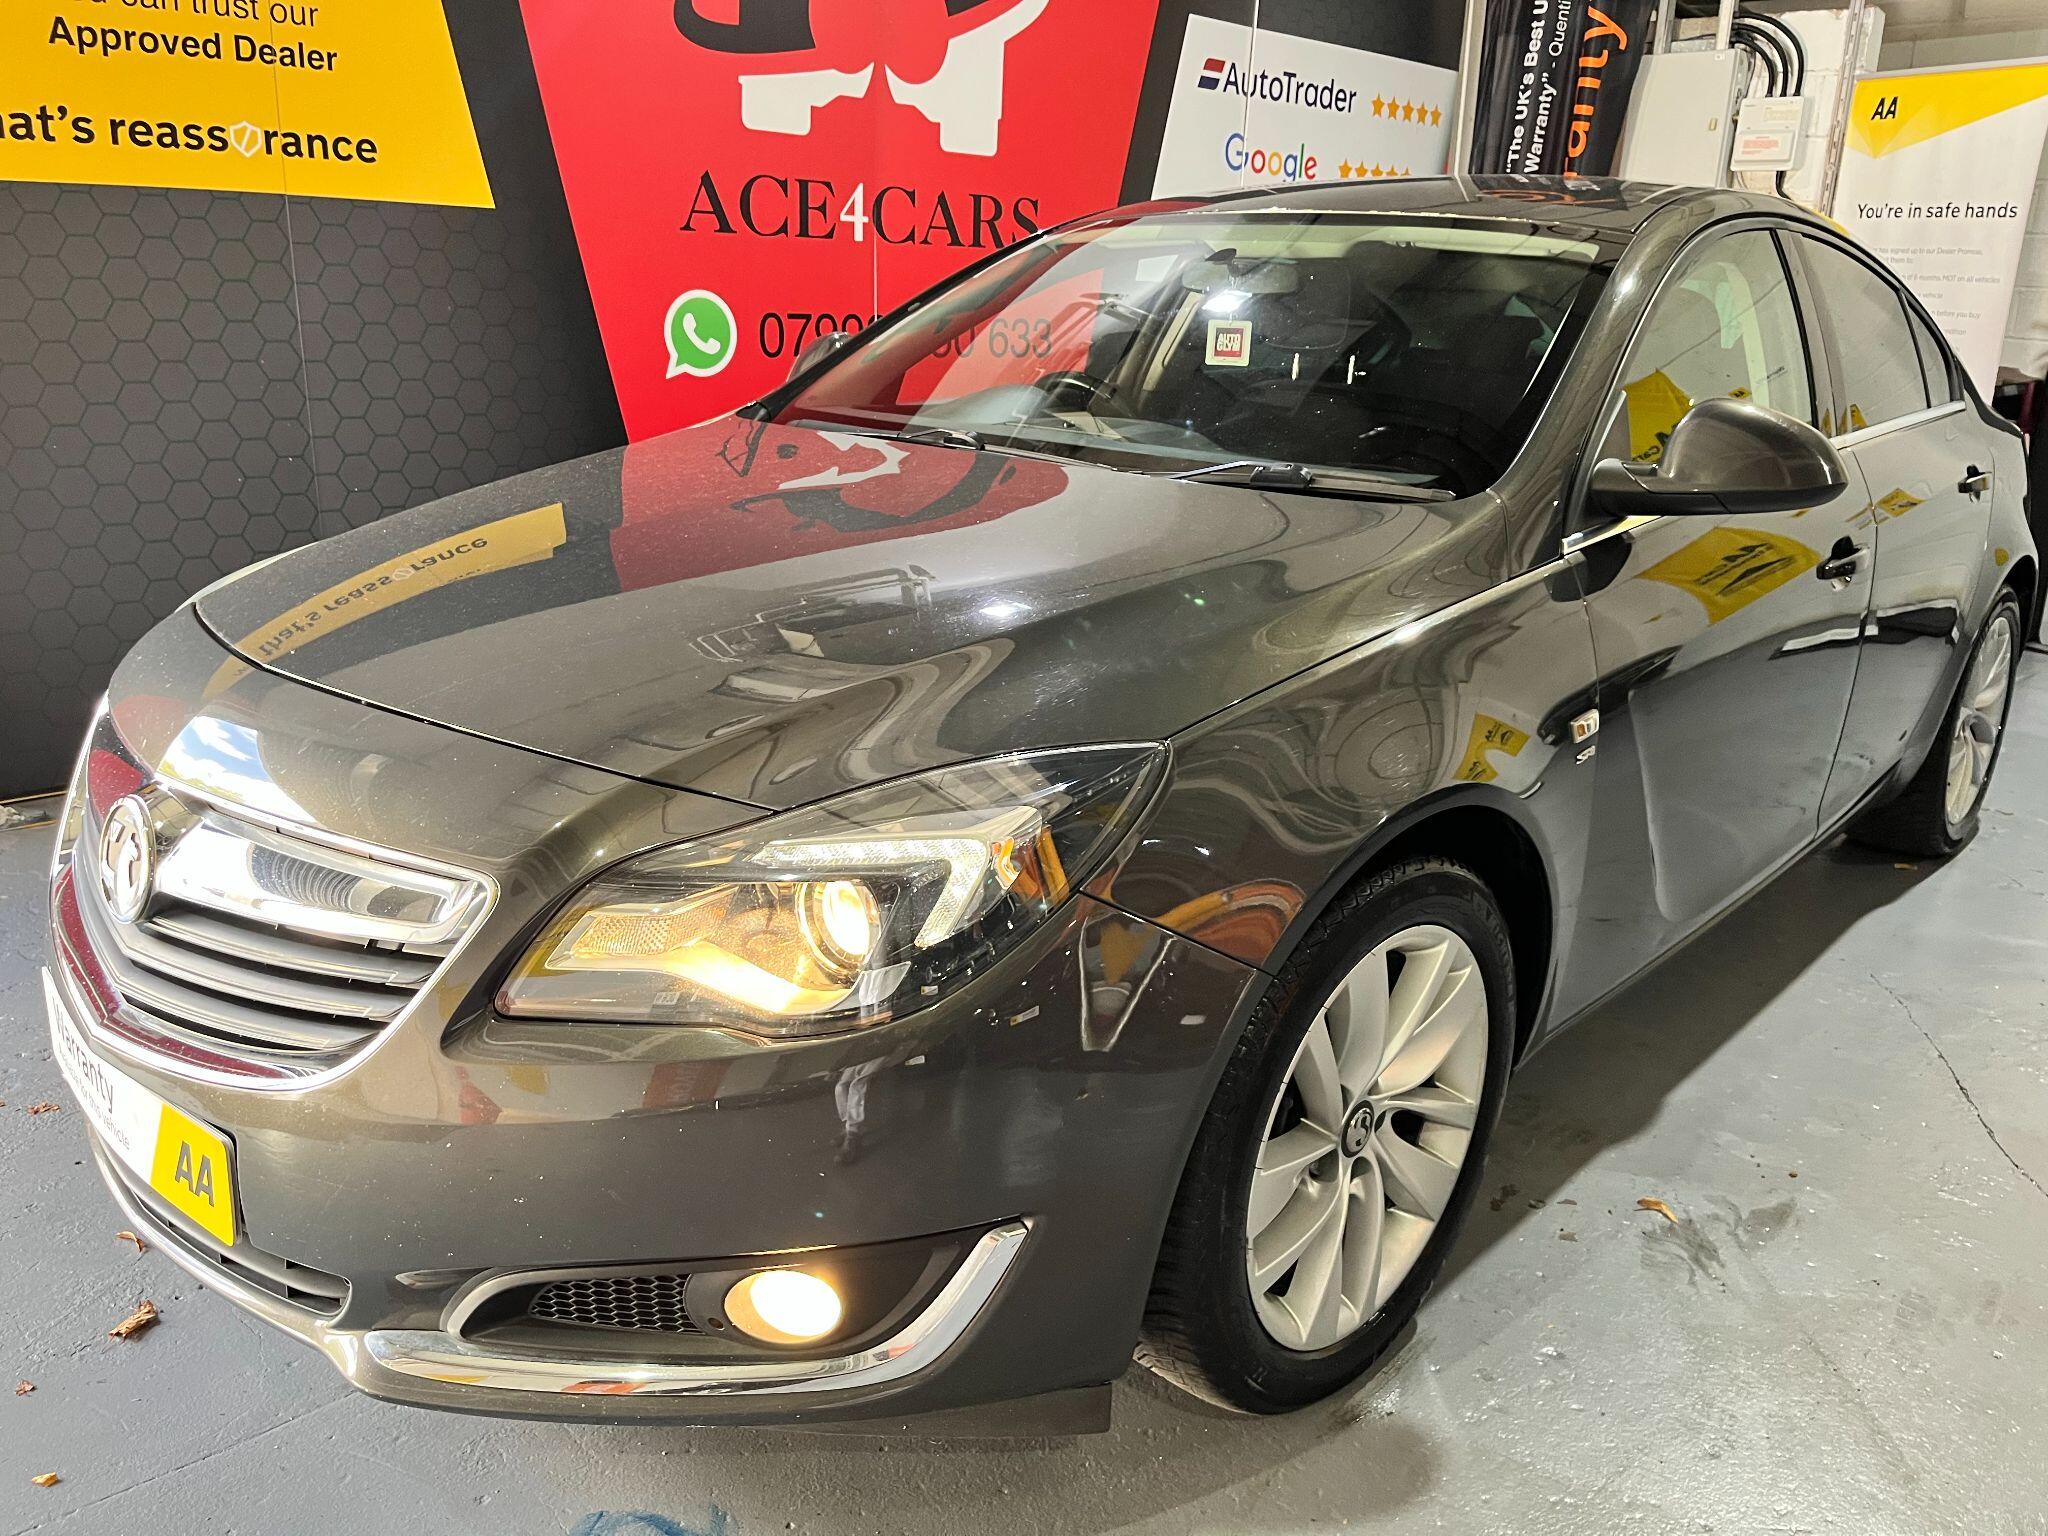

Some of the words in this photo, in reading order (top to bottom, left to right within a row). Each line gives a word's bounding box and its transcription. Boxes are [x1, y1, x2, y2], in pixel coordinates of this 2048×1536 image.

[270, 2, 319, 27] our
[48, 15, 223, 59] Approved
[233, 34, 338, 72] Dealer
[1523, 19, 1546, 67] Best
[1222, 62, 1358, 114] AutoTrader
[1870, 96, 1899, 121] AA
[0, 104, 96, 145] at's
[1224, 132, 1318, 181] Google
[679, 169, 1040, 248] ACE4CARS
[1857, 203, 1903, 219] You're
[1908, 202, 1922, 218] in
[1926, 202, 1960, 219] safe
[1965, 202, 2019, 219] hands
[759, 312, 883, 358] 079
[988, 318, 1052, 359] 633
[174, 1139, 215, 1208] AA
